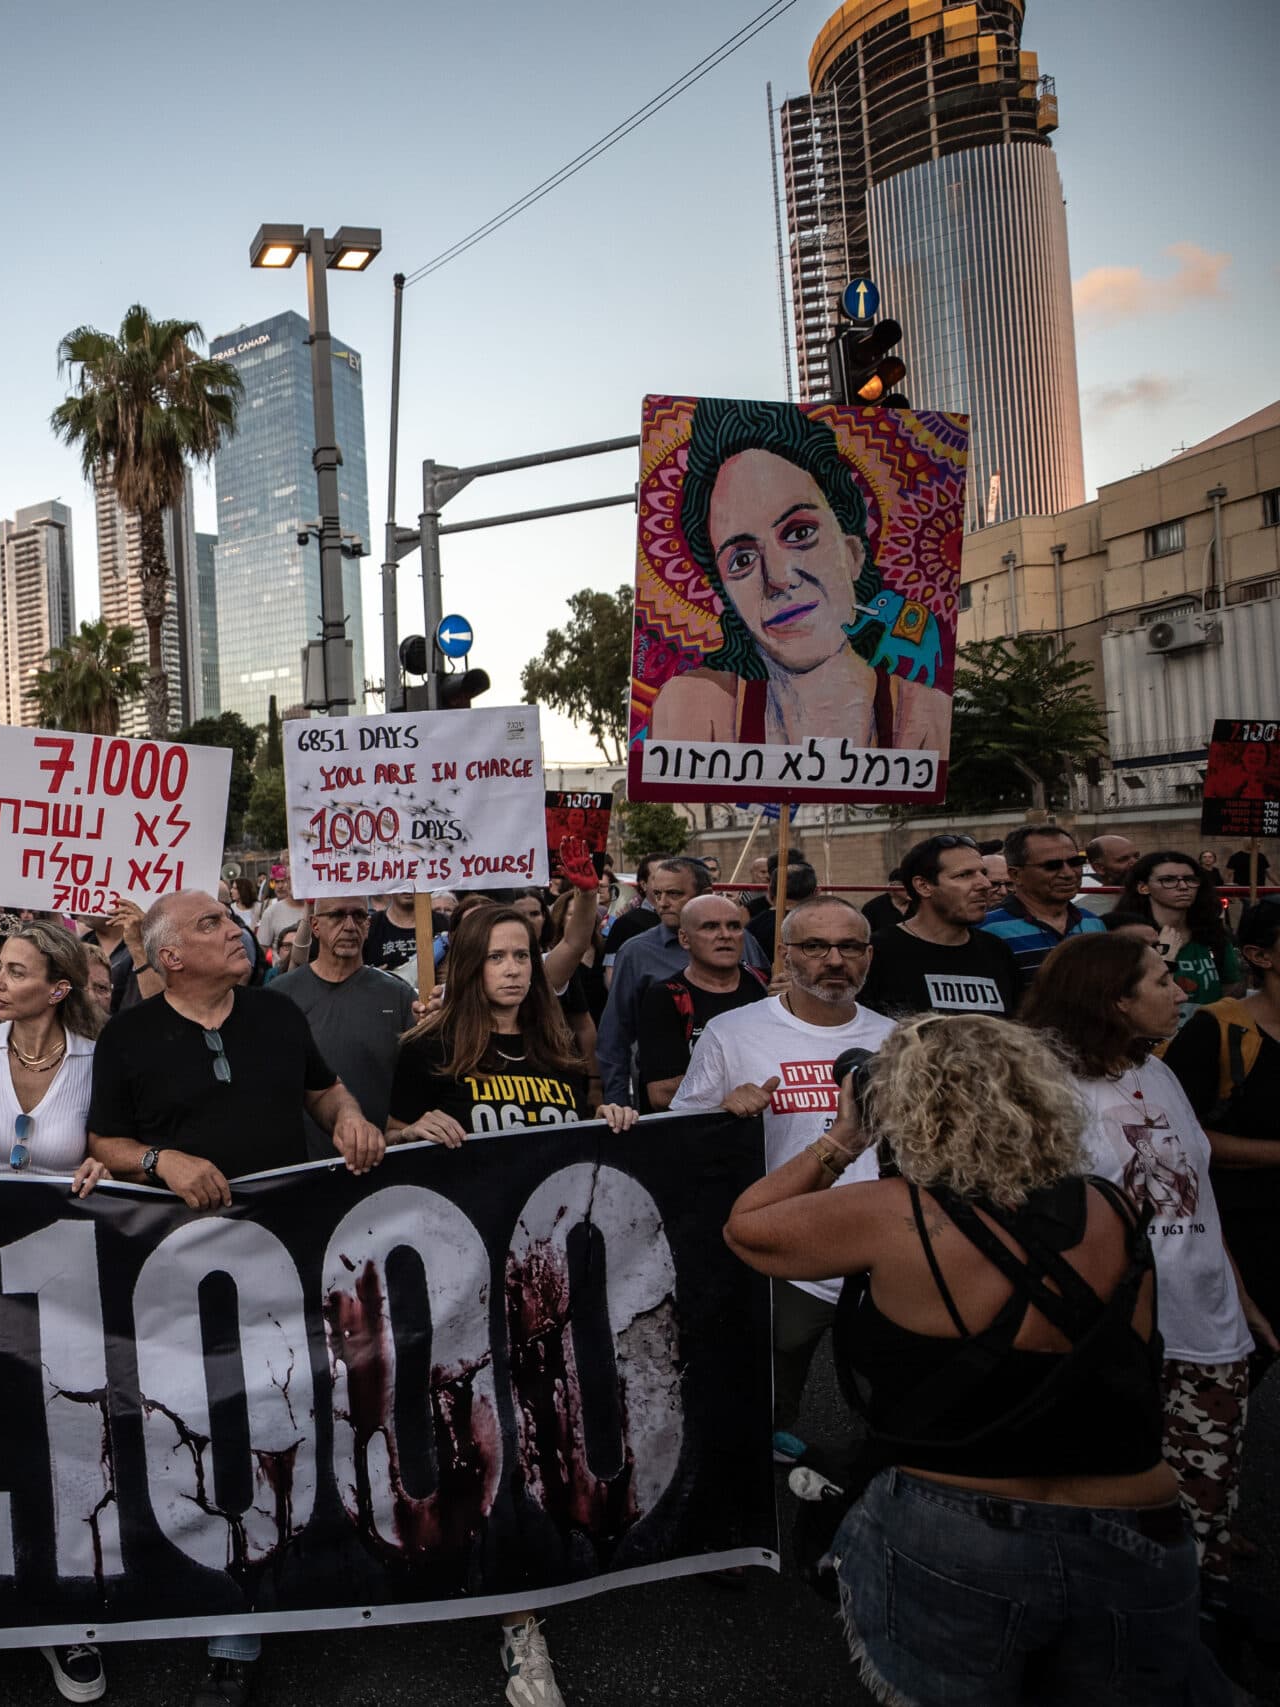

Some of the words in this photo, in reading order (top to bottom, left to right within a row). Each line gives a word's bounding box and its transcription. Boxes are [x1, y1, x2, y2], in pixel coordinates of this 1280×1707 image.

[237, 334, 271, 353] CANADA
[349, 353, 360, 370] EY
[298, 729, 350, 752] 6851
[360, 725, 420, 750] DAYS
[34, 736, 189, 802] 7.1000
[320, 765, 366, 791] YOU
[374, 763, 417, 785] ARE
[432, 761, 457, 782] IN
[465, 758, 534, 781] CHARGE
[649, 742, 763, 783] תחזור
[778, 739, 825, 783] לא
[840, 738, 937, 790] כרמל
[134, 803, 191, 848] לא
[308, 806, 400, 855] 1000
[21, 842, 113, 887] נסלח
[127, 853, 184, 894] ולא
[312, 861, 353, 883] THE
[357, 859, 419, 882] BLAME
[426, 858, 451, 880] IS
[460, 848, 535, 880] YOURS!
[931, 981, 998, 1004] כוסומו
[463, 1075, 567, 1105] באוקטובר
[785, 1064, 834, 1084] חקירה
[773, 1091, 831, 1111] עכשיו!
